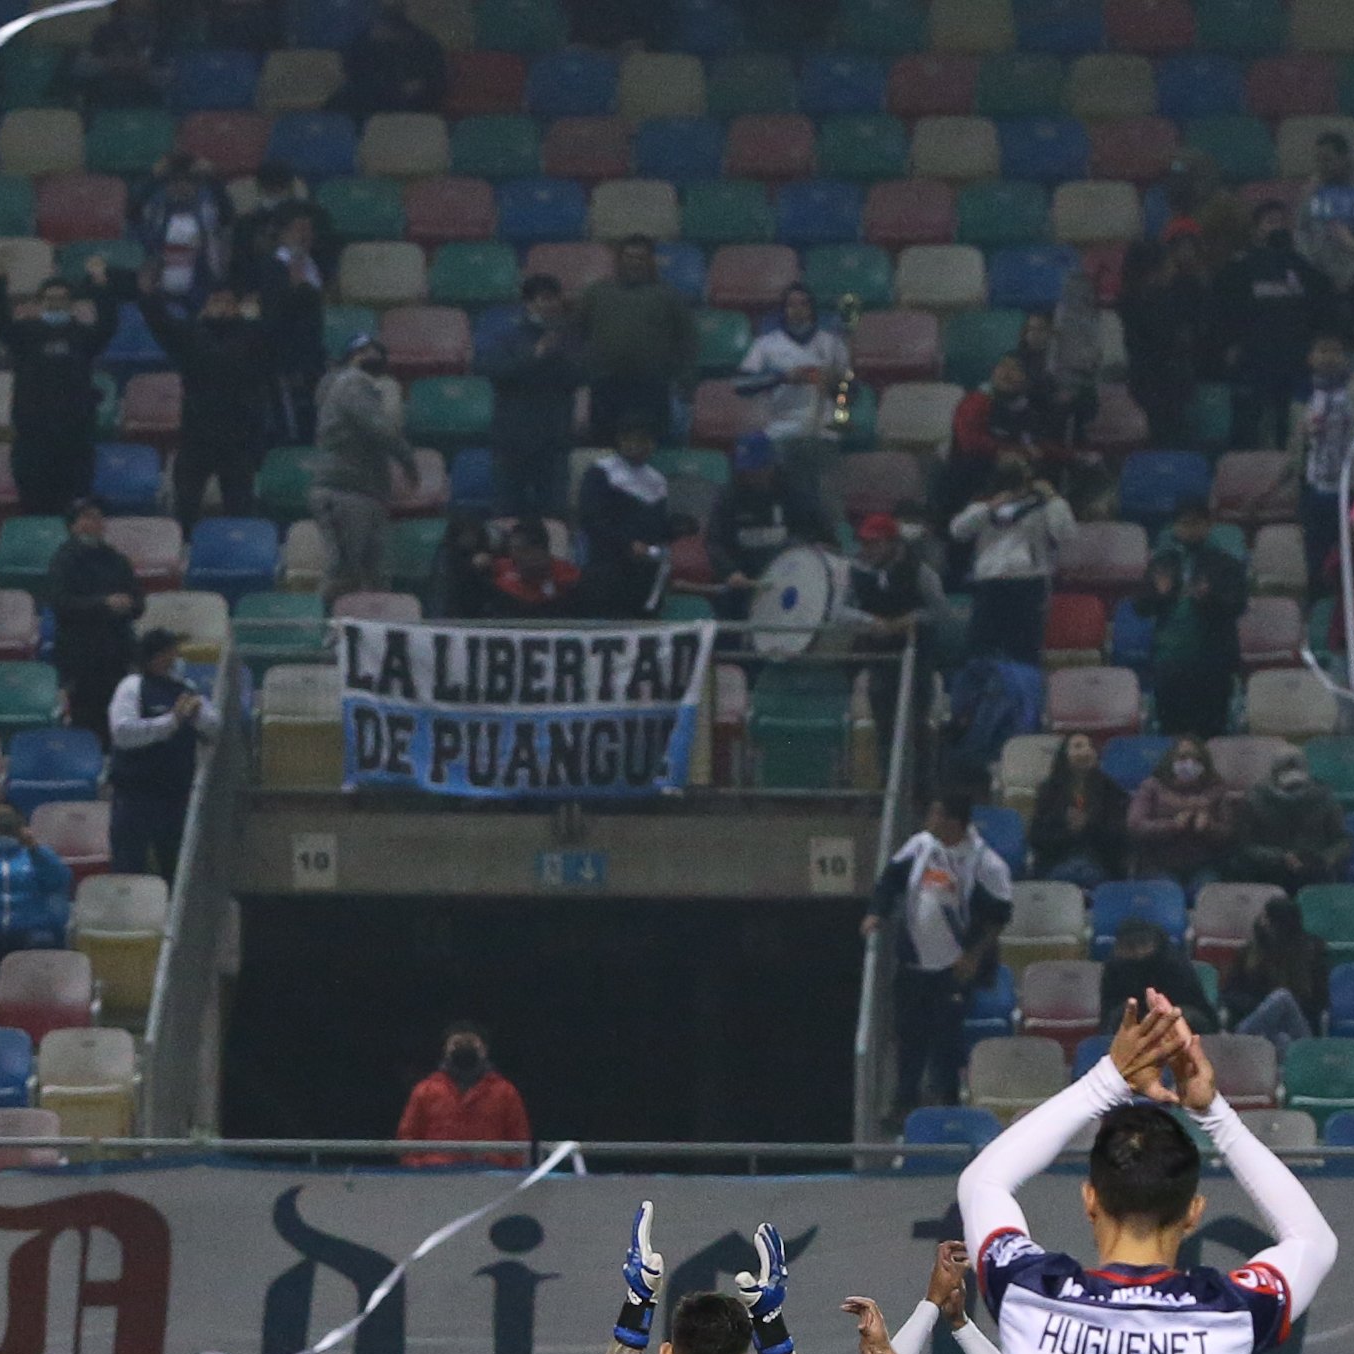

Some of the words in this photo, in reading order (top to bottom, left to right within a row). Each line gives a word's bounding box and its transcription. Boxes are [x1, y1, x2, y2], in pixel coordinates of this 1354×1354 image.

[346, 625, 415, 698] LA
[434, 631, 700, 703] LIBERTAD
[354, 707, 415, 774] DE
